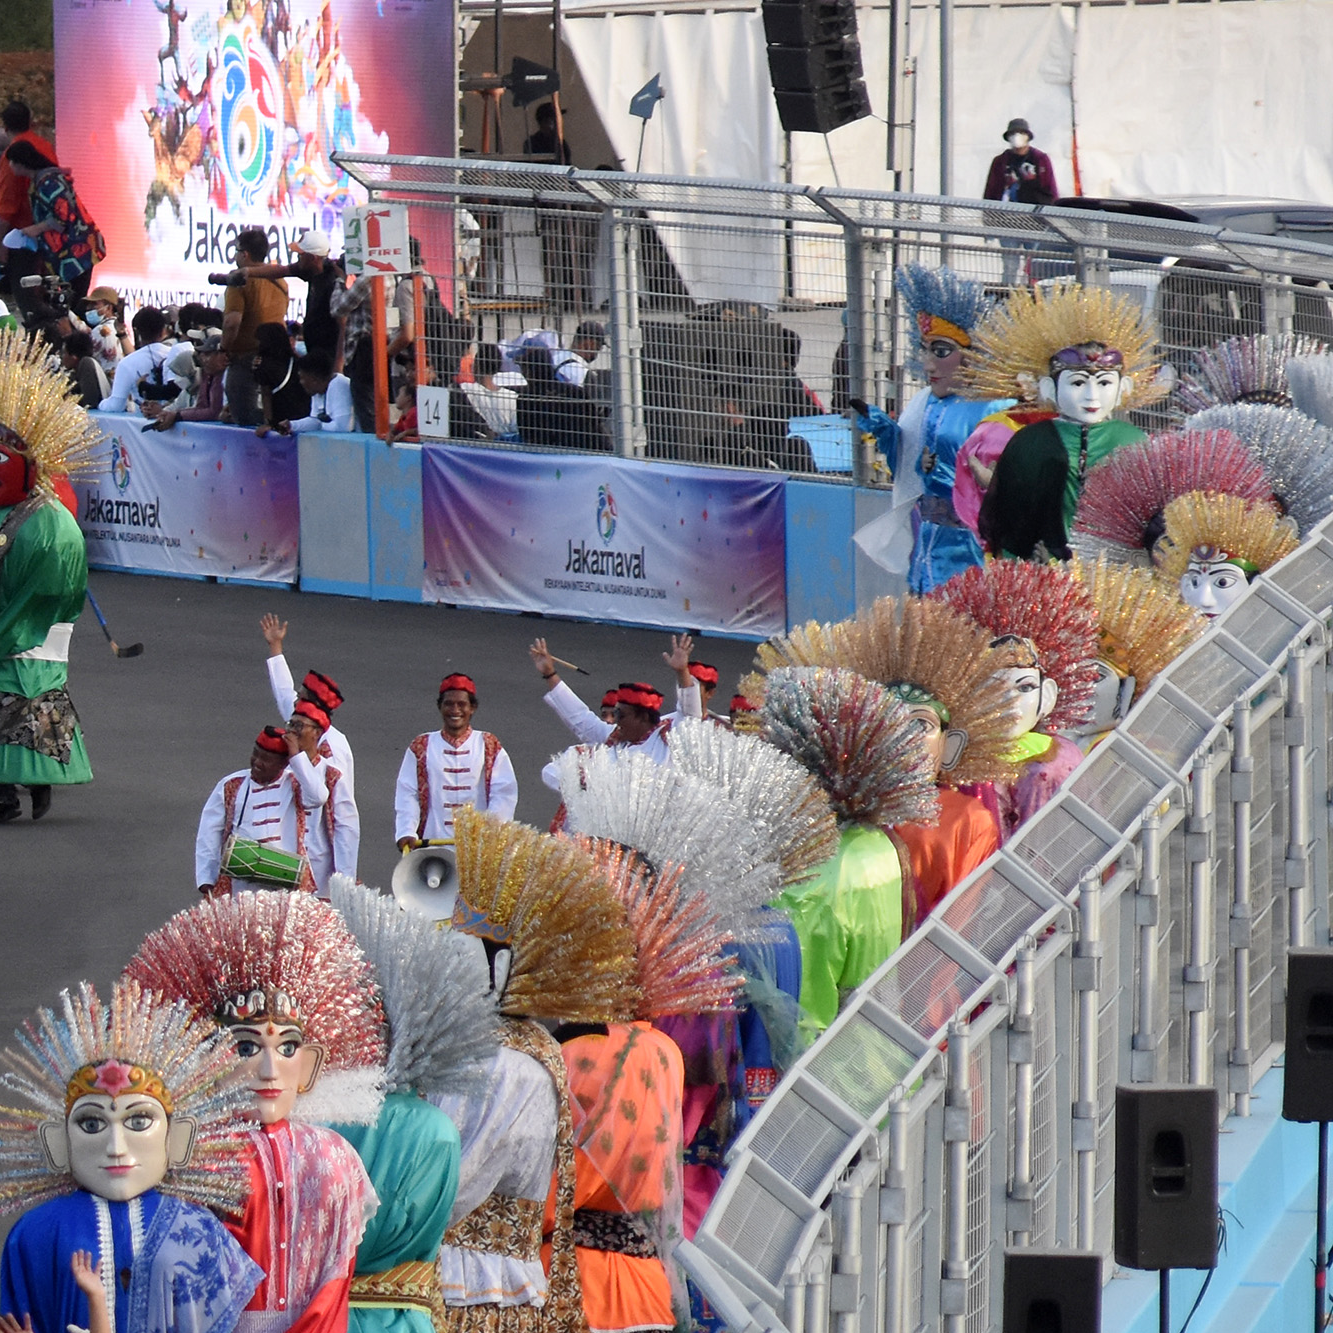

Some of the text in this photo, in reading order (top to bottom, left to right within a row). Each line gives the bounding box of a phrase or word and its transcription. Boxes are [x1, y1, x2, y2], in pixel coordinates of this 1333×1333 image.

[368, 247, 402, 257] FIRE
[423, 398, 441, 426] 14
[84, 489, 162, 529] Jakarnaval
[565, 539, 647, 580] Jakarnaval
